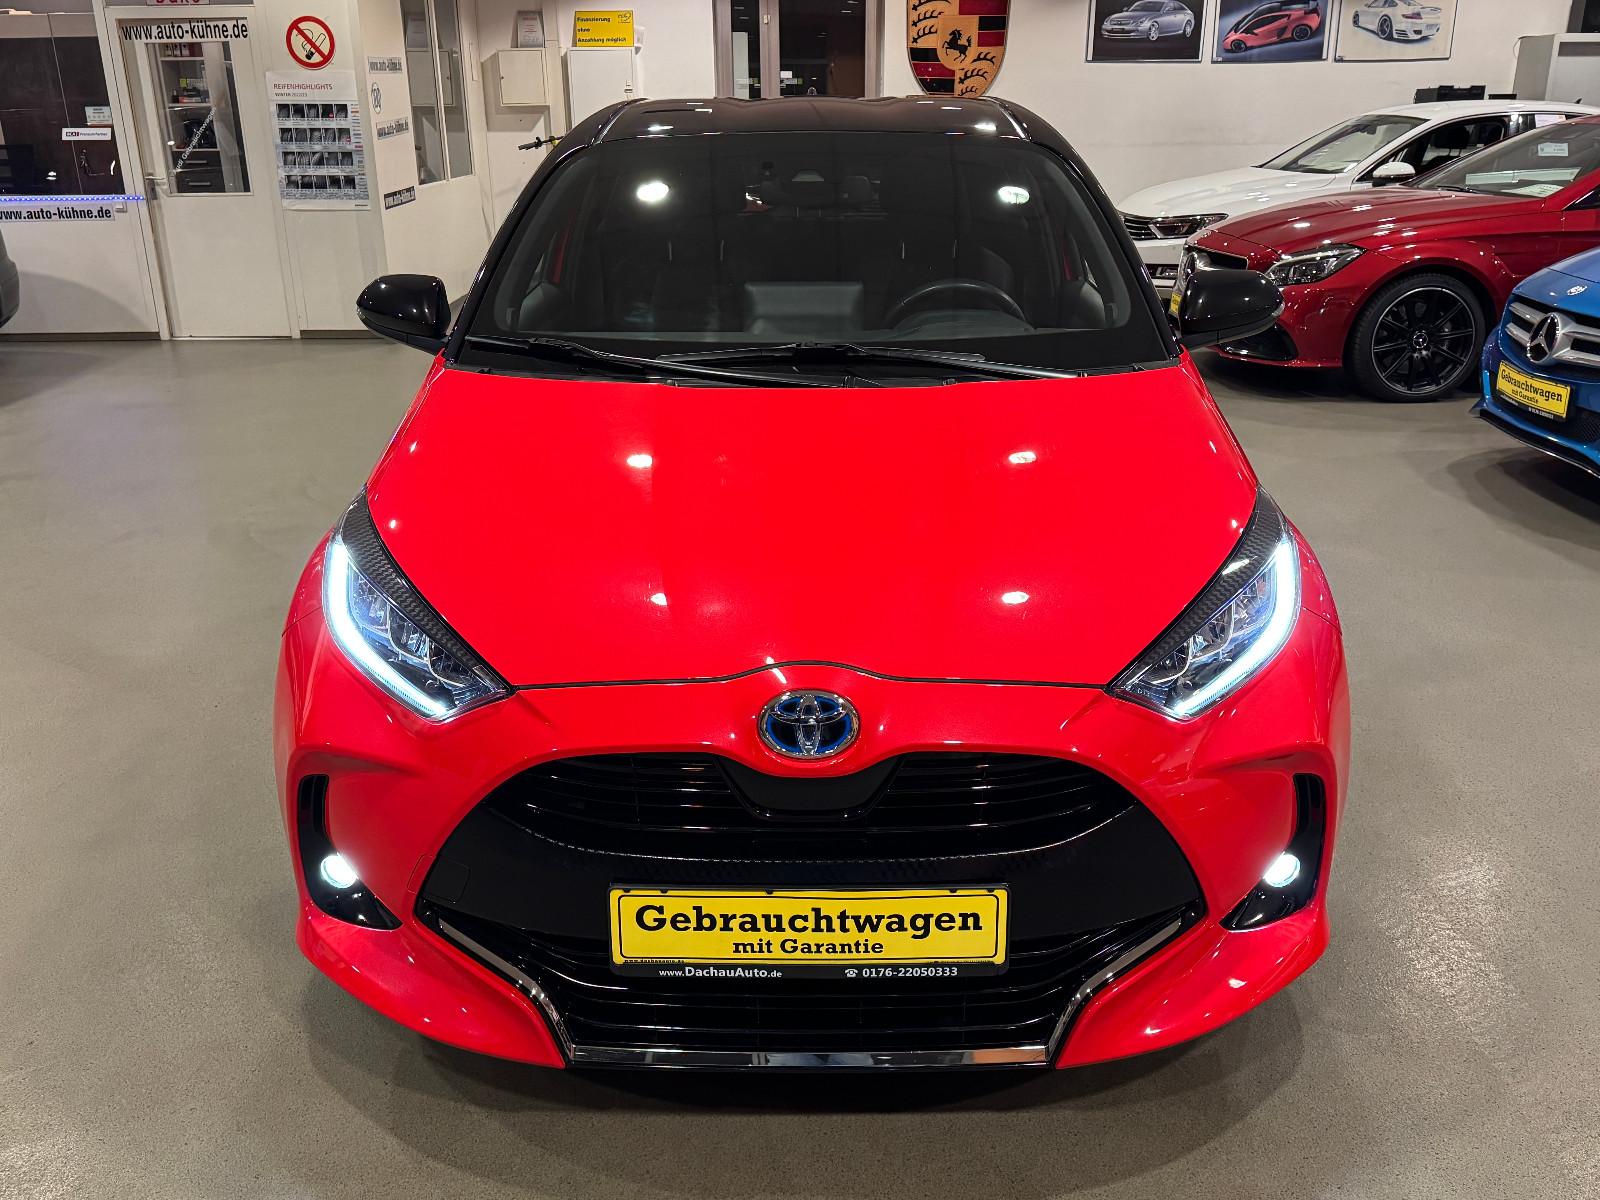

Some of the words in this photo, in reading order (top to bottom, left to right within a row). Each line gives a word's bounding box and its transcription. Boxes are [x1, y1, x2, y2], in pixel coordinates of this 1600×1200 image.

[122, 19, 249, 41] www.auto-kühne.de
[181, 106, 217, 160] Gebrauchtwagen
[1501, 369, 1563, 403] Gebrauchtwagen
[635, 903, 983, 940] Gebrauchtwagen
[732, 937, 773, 954] mit
[779, 937, 885, 955] Garantie
[658, 966, 783, 979] www.DachauAuto.de
[862, 967, 959, 978] 0176-22050333
